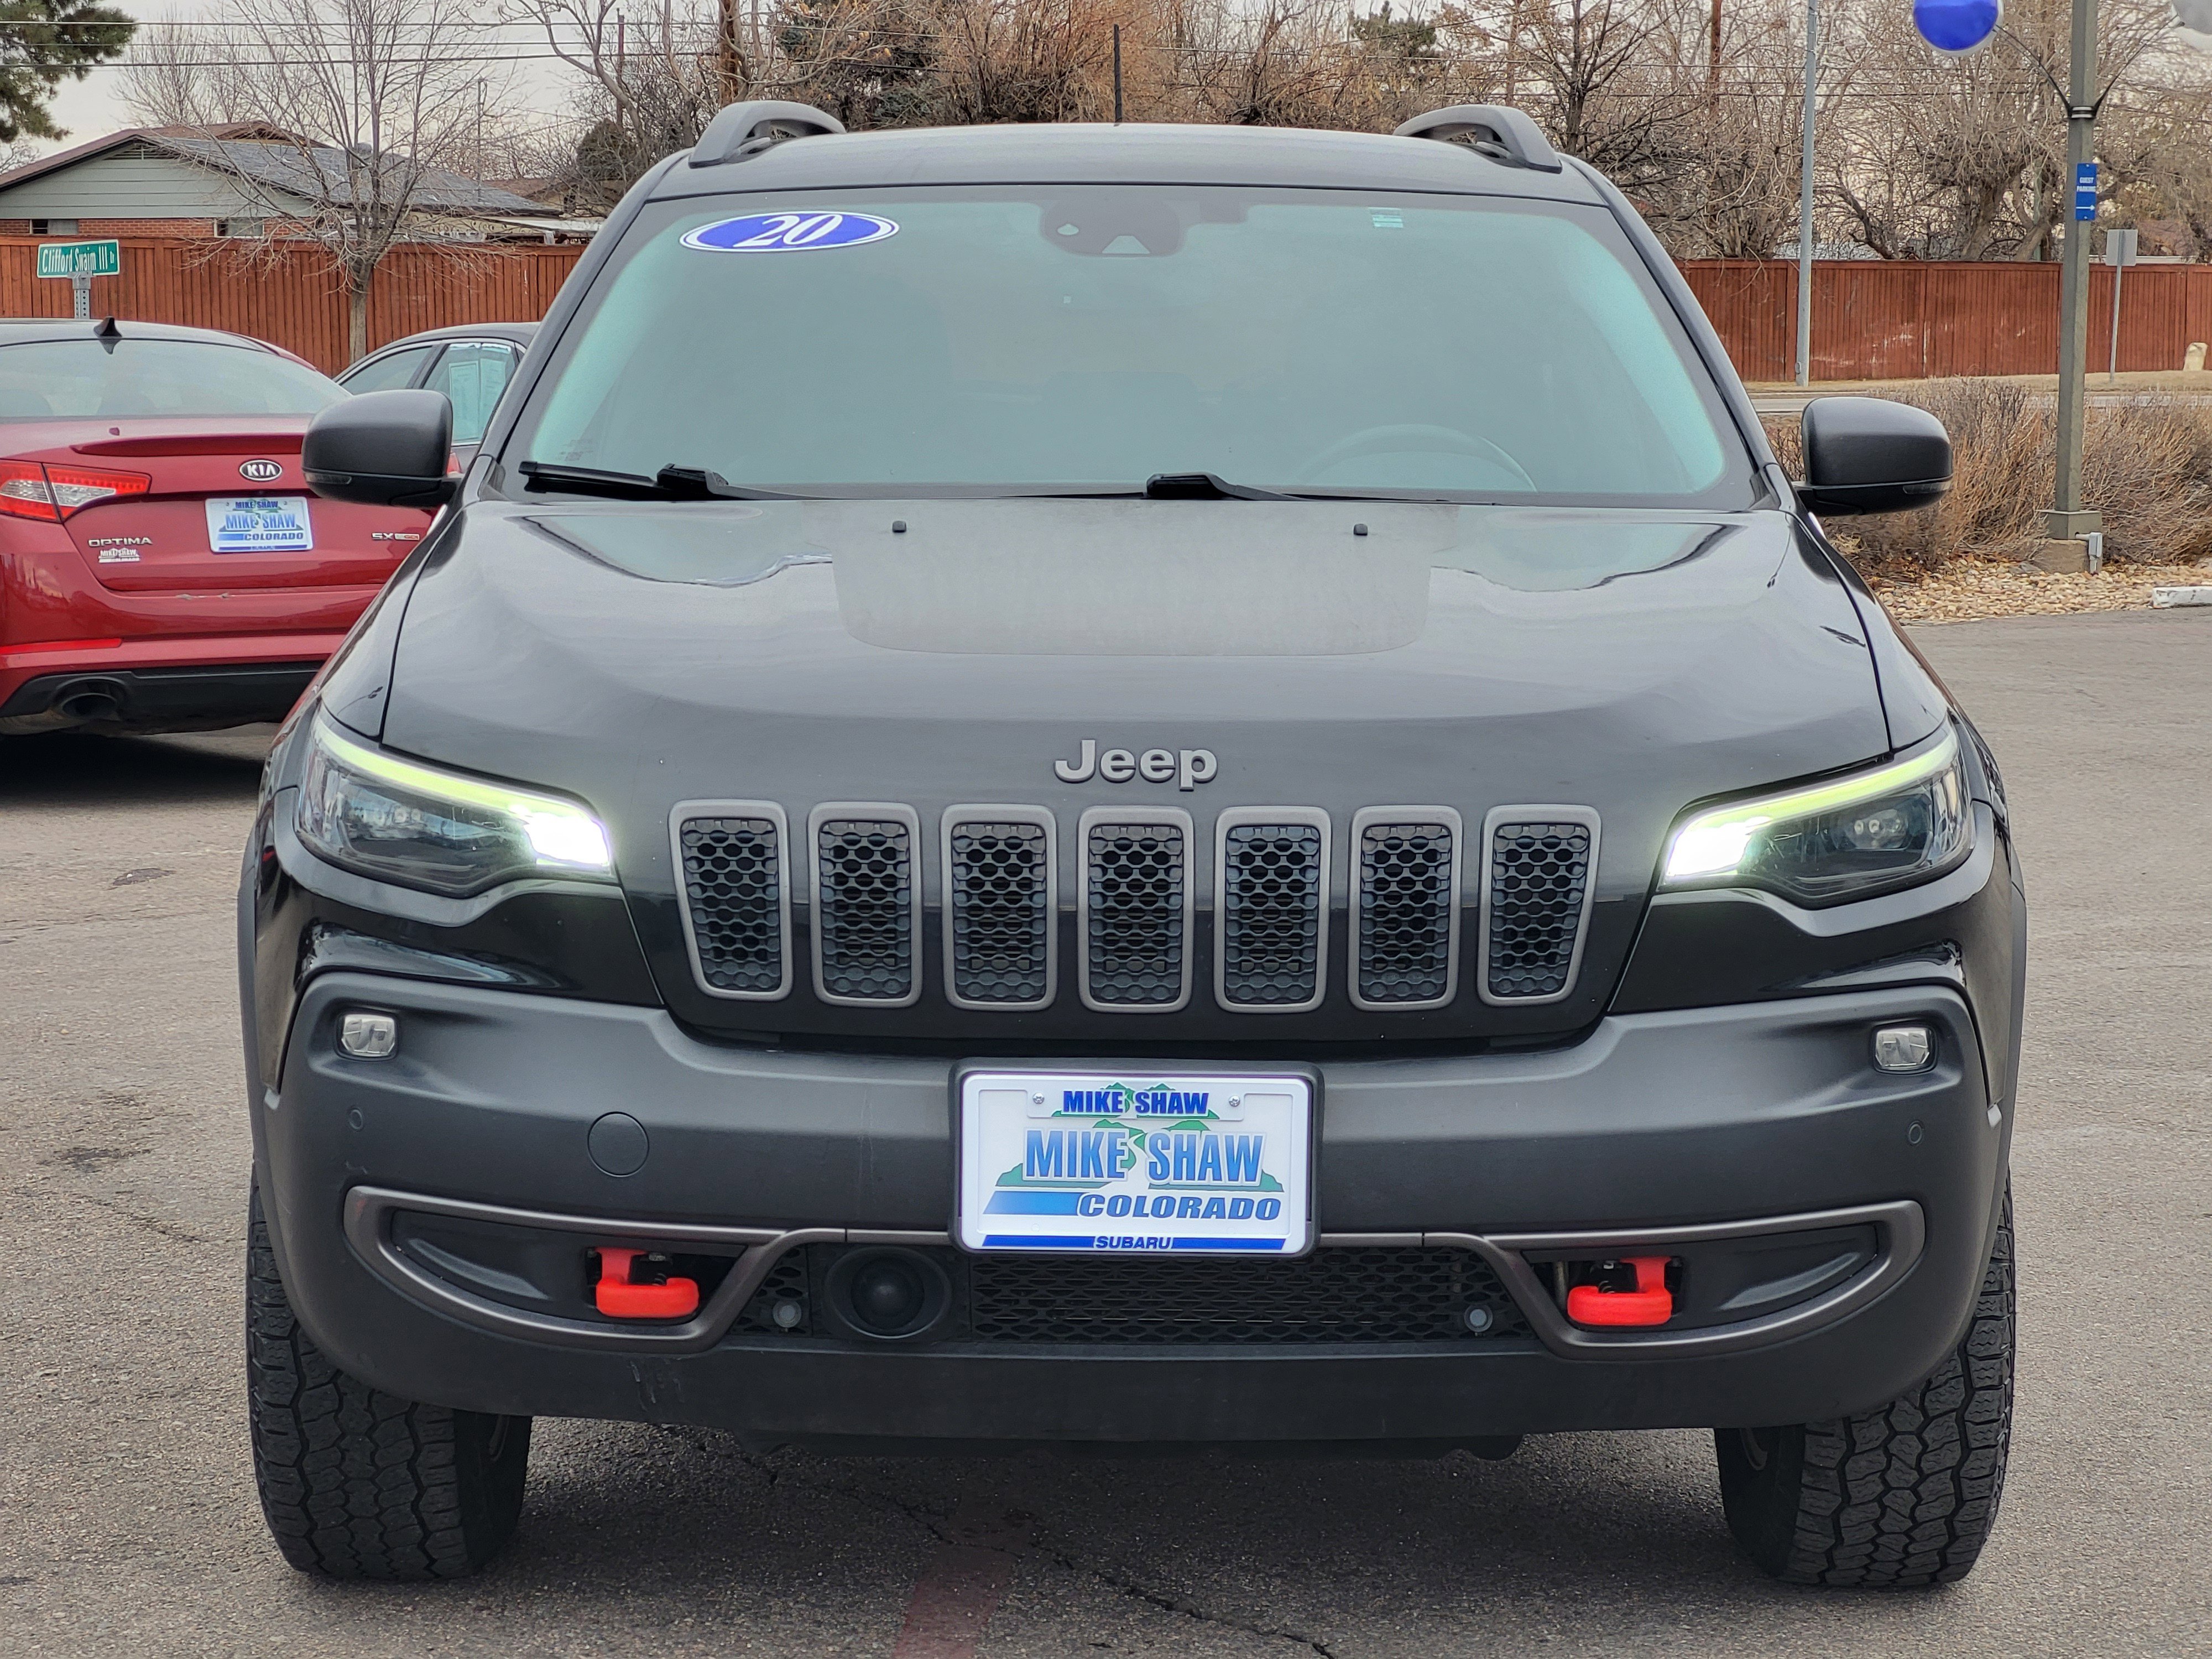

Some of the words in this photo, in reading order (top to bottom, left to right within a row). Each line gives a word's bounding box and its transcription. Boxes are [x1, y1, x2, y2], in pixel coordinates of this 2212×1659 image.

[732, 214, 843, 248] 20
[42, 248, 73, 273] Clifford
[75, 247, 96, 272] Swaim
[247, 464, 276, 476] KIA
[225, 514, 257, 529] MIKE
[263, 513, 295, 528] SHAW
[88, 537, 153, 547] OPTIMA
[244, 533, 304, 541] COLORADO
[1054, 739, 1218, 791] Jeep
[1063, 1091, 1124, 1113] MIKE
[1135, 1092, 1209, 1114] SHAW
[1026, 1130, 1128, 1178] MIKE
[1148, 1133, 1264, 1182] SHAW
[1079, 1194, 1281, 1220] COLORADO
[1095, 1236, 1172, 1249] SUBARU
